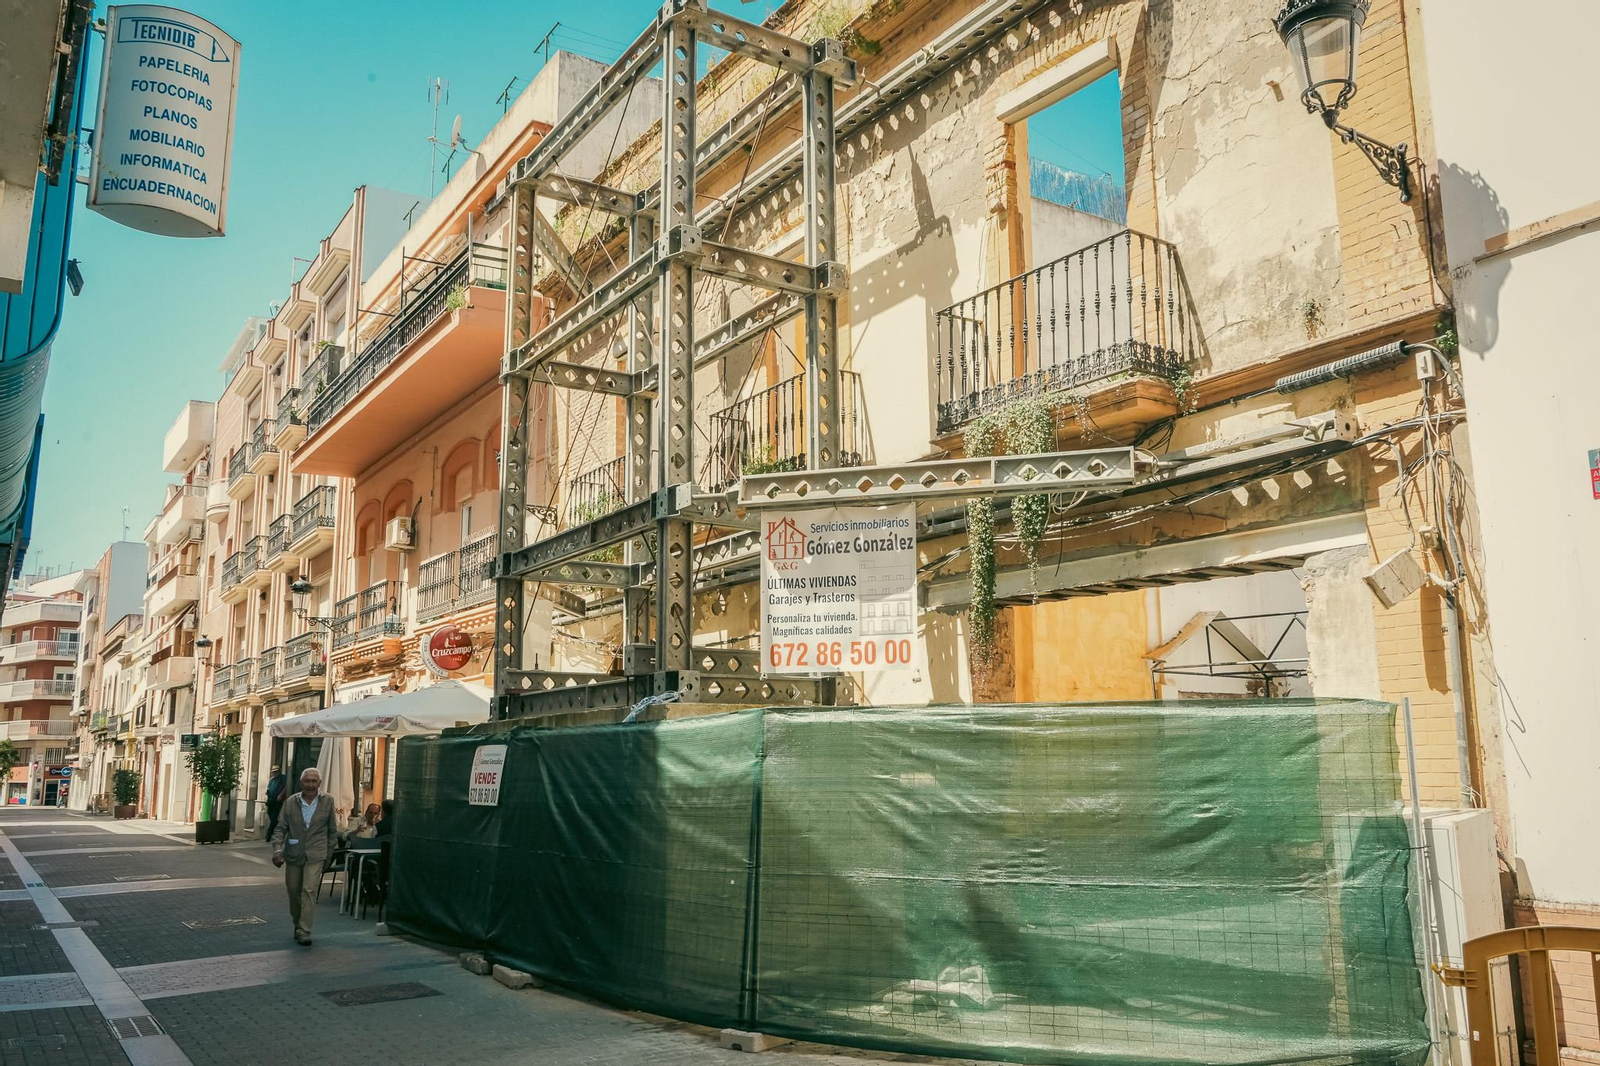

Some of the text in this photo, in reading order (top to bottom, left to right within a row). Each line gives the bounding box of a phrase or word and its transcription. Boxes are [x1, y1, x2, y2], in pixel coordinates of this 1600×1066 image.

[131, 19, 196, 49] TECNIDIB
[138, 55, 210, 86] PAPELERIA
[131, 79, 213, 112] FOTOCOPIAS
[143, 105, 198, 130] PLANOS
[129, 129, 205, 158] MOBILIARIO
[120, 153, 207, 185] INFORMATICA
[102, 178, 217, 215] ENCUADERNACION
[810, 517, 910, 534] Servicios inmobiliarios
[806, 532, 914, 556] Gómez González
[773, 561, 798, 571] G&G
[767, 575, 857, 590] ÚLTIMAS VIVIENDAS
[768, 592, 855, 606] Garajes y Trasteros
[767, 611, 858, 624] Personaliza tu vivienda.
[772, 625, 853, 638] Magníficas calidades
[431, 645, 472, 658] Cruzcampo
[770, 639, 912, 667] 672 86 50 00
[474, 772, 497, 785] VENDE
